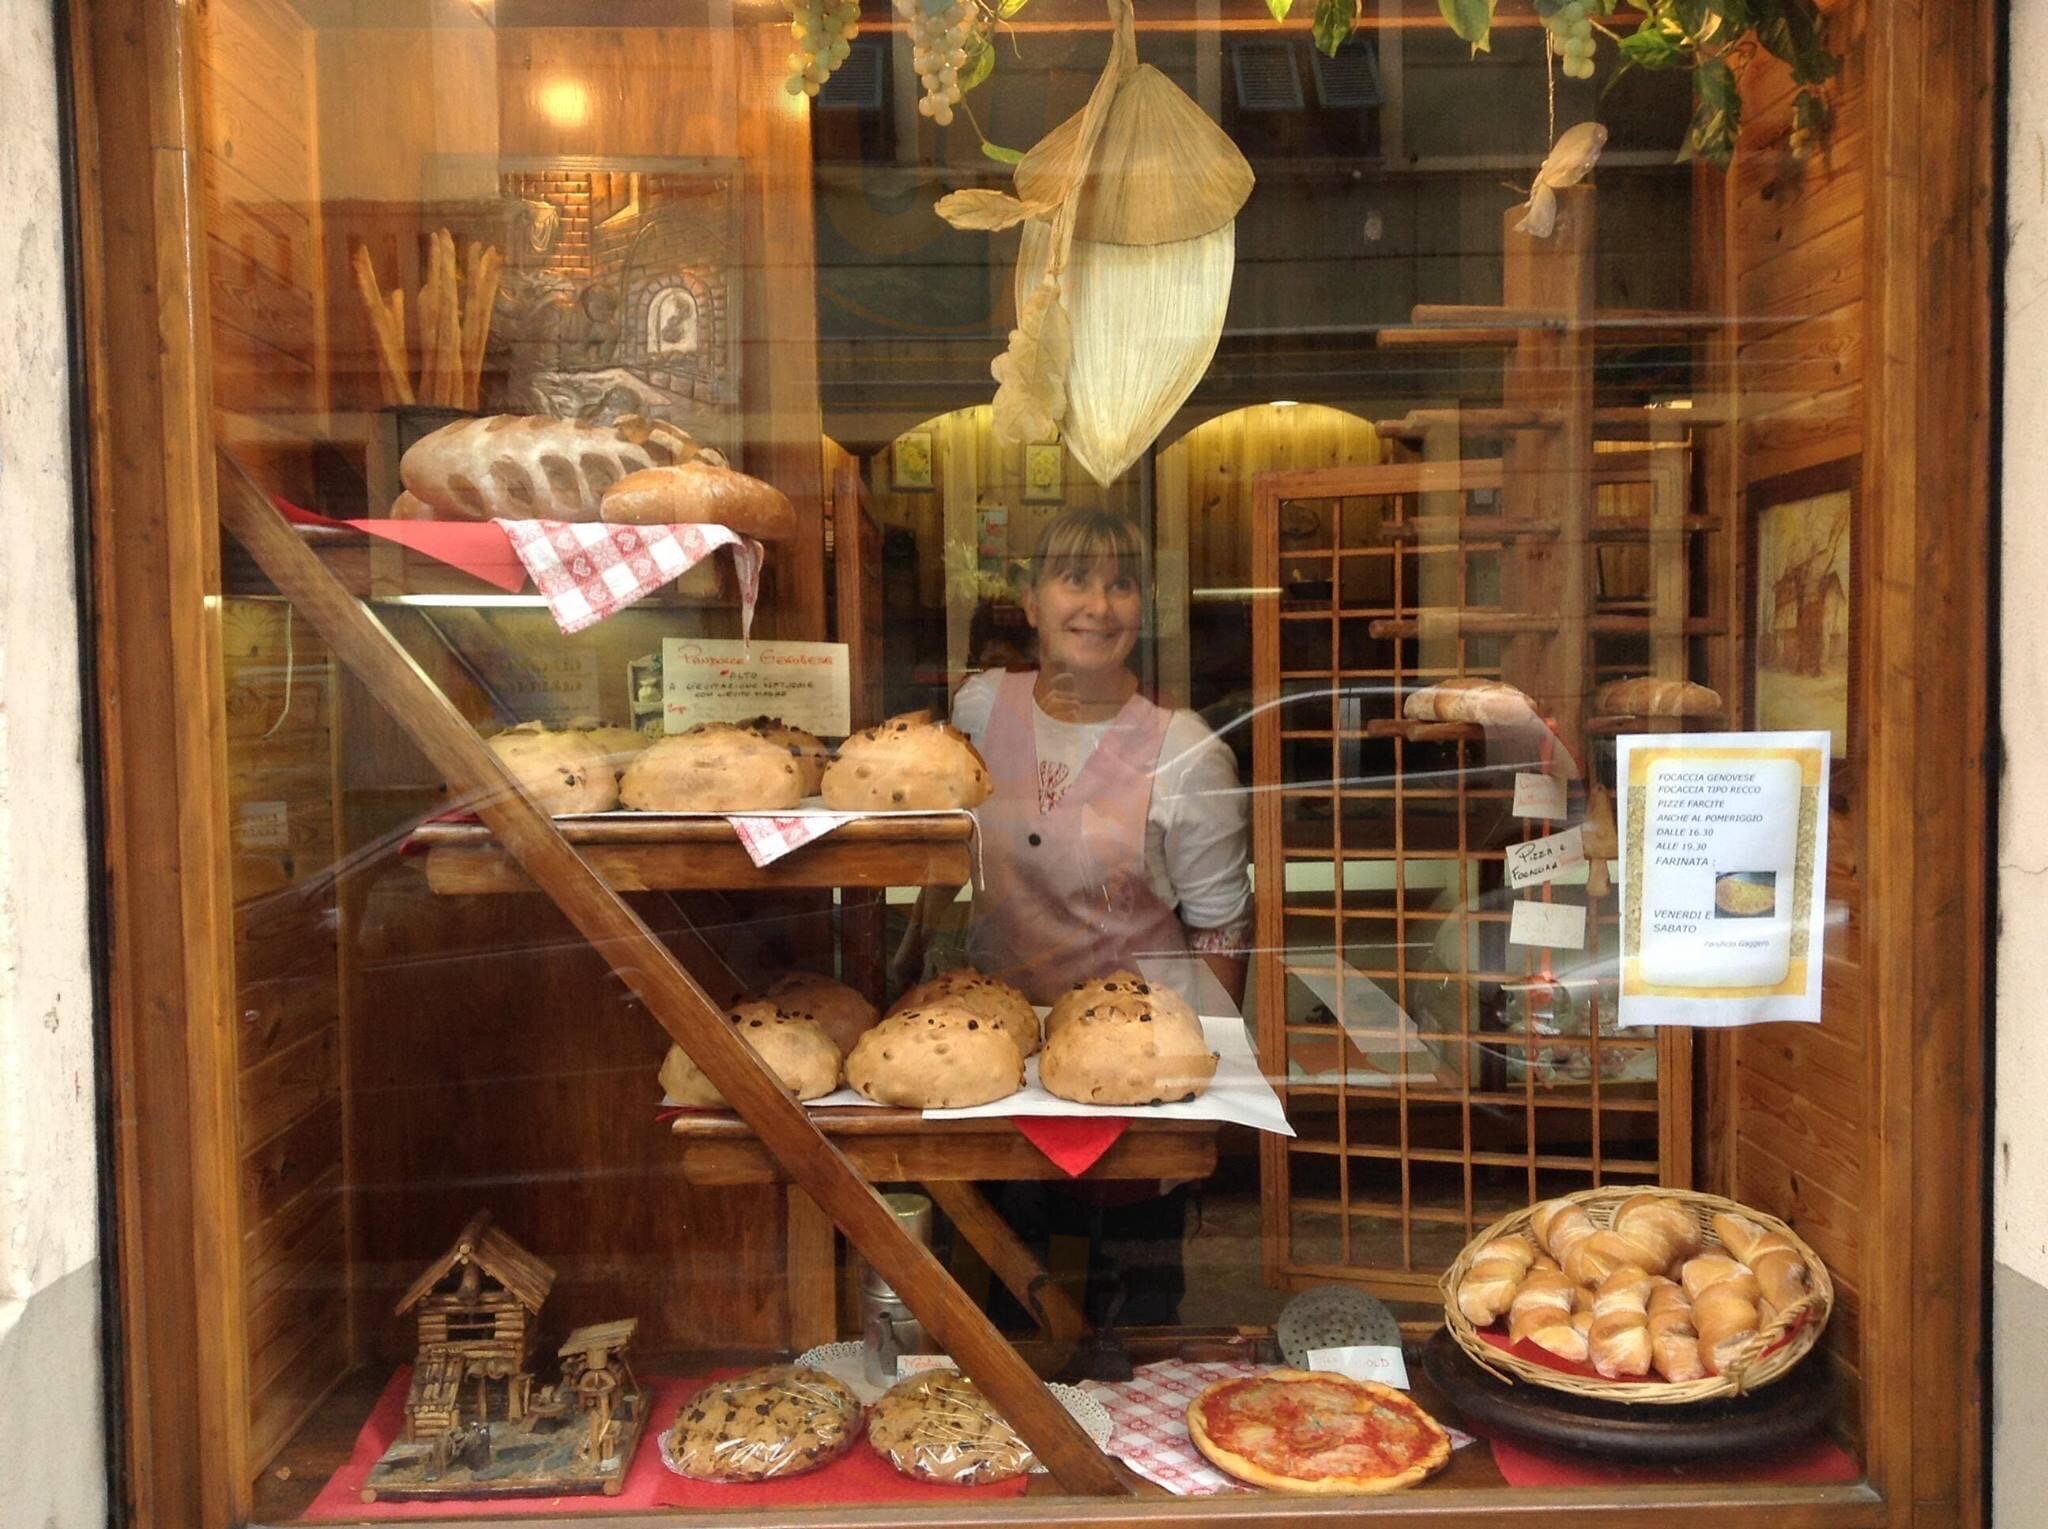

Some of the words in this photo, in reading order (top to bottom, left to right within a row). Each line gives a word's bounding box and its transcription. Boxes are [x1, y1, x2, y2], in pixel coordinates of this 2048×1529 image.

[1658, 773, 1704, 782] FOCACCIA
[1707, 774, 1756, 782] GENOVESE
[1658, 785, 1704, 794] FOCACCIA
[1708, 785, 1728, 794] TIPO
[1731, 785, 1761, 794] RECCO
[1658, 799, 1686, 808] PIZZE
[1687, 799, 1725, 808] FARCITE
[1657, 814, 1690, 822] ANCHE
[1691, 814, 1704, 822] AL
[1706, 814, 1763, 823] POMERIGGIO
[1656, 828, 1686, 837] DALLE
[1689, 828, 1714, 837] 16.30
[1656, 842, 1678, 851] ALLE
[1682, 842, 1707, 851] 19.30
[1656, 856, 1709, 866] FARINATA
[1704, 911, 1711, 919] E
[1654, 924, 1697, 933] SABATO
